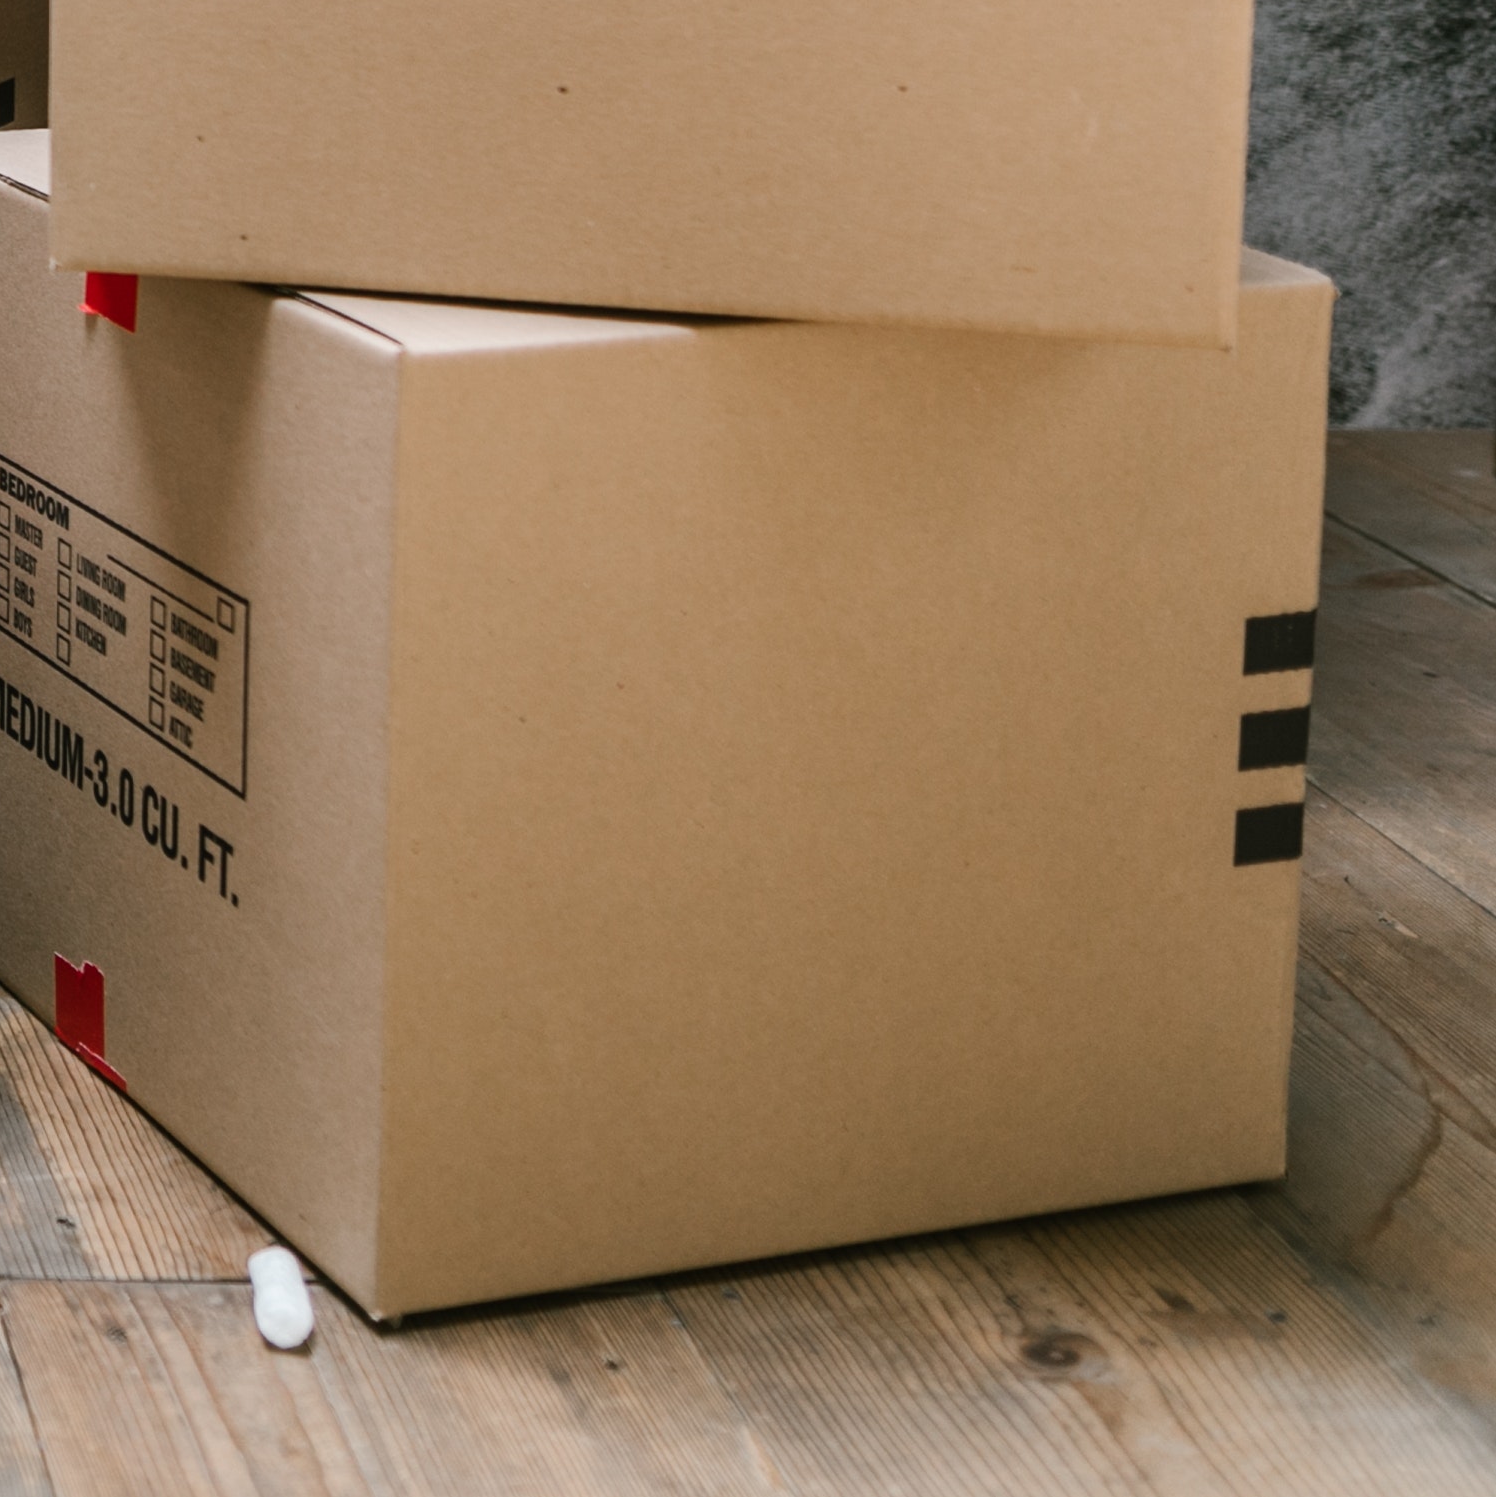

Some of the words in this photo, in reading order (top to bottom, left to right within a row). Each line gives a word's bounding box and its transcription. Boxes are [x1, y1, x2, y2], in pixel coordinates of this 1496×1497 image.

[0, 466, 70, 531] BEDROOM
[14, 514, 43, 550] MASTER
[14, 546, 37, 577] GUEST
[76, 553, 101, 587] LIVING
[102, 569, 126, 602] ROOM
[14, 576, 35, 608] GIRLS
[76, 585, 102, 620] DINING
[103, 602, 127, 637] ROOM
[13, 608, 33, 638] BOYS
[75, 617, 107, 656] KITCHEN
[171, 613, 218, 660] BATHROOM
[171, 646, 215, 693] BASEMENT
[170, 681, 205, 723] GARAGE
[169, 716, 193, 750] ATTIC
[141, 784, 188, 871] CU.
[198, 823, 239, 908] FT.
